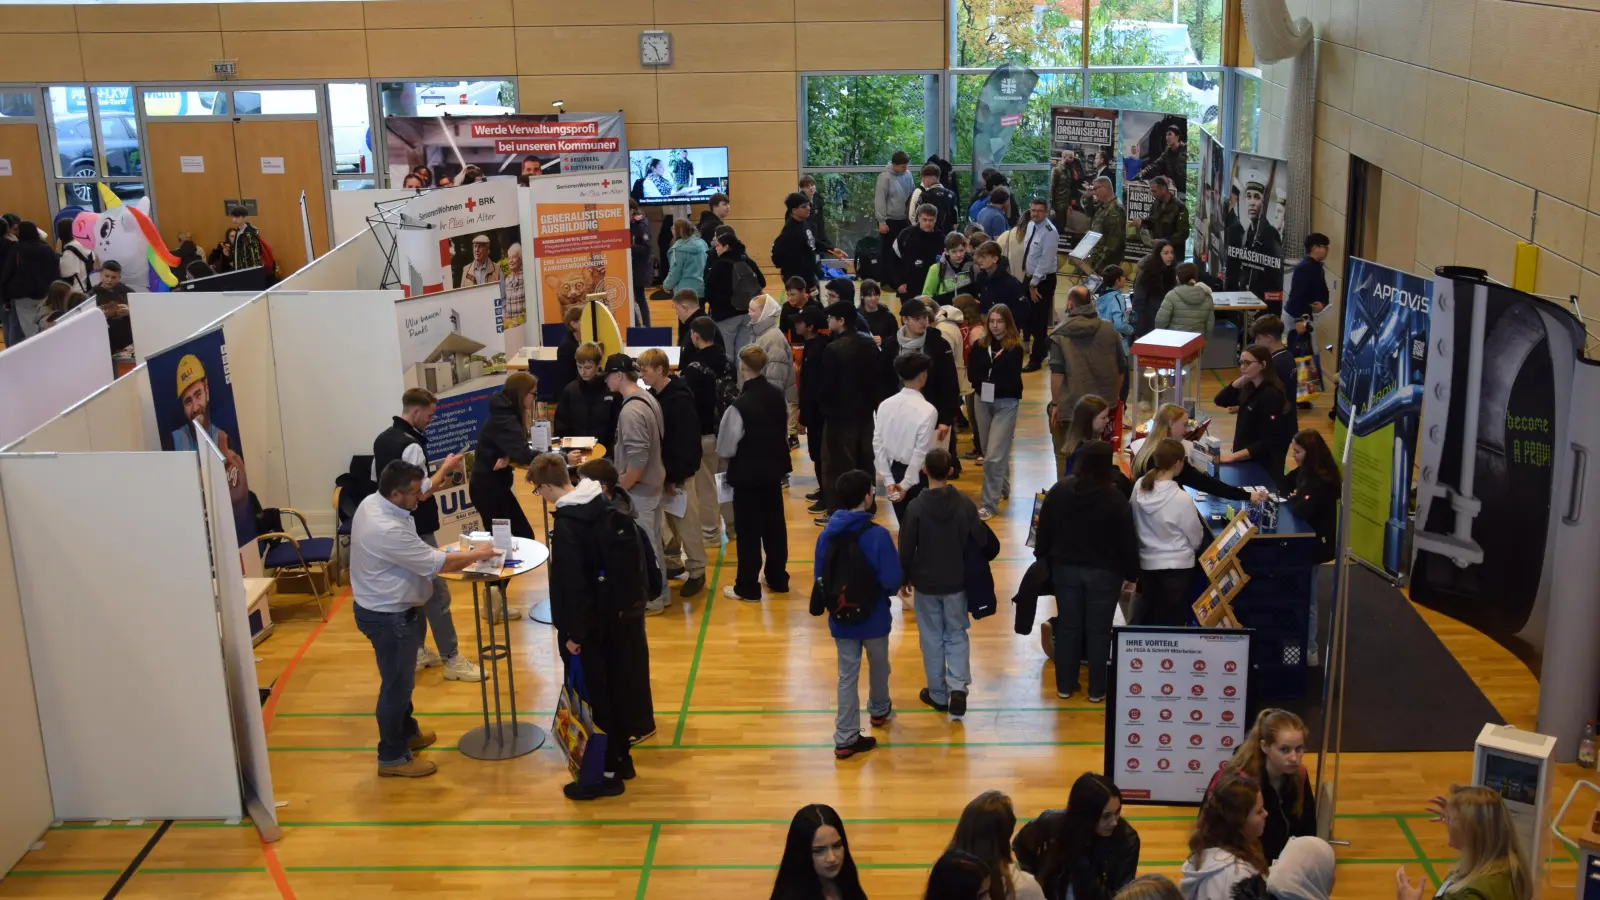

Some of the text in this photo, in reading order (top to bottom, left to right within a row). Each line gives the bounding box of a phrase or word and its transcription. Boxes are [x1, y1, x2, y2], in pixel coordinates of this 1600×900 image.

[475, 124, 595, 136] Werde Verwaltungsprofi
[1058, 126, 1110, 138] ORGANISIEREN.
[499, 140, 616, 152] bei unseren Kommunen
[419, 196, 495, 221] SeniorenWohnen BRK
[1130, 202, 1142, 211] UND
[448, 218, 464, 230] Plus
[476, 213, 496, 222] Alter
[540, 208, 622, 224] GENERALISTISCHE
[542, 220, 598, 234] AUSBILDUNG
[1228, 246, 1280, 268] REPRÄSENTIEREN
[1506, 410, 1548, 433] become
[440, 489, 473, 515] UL
